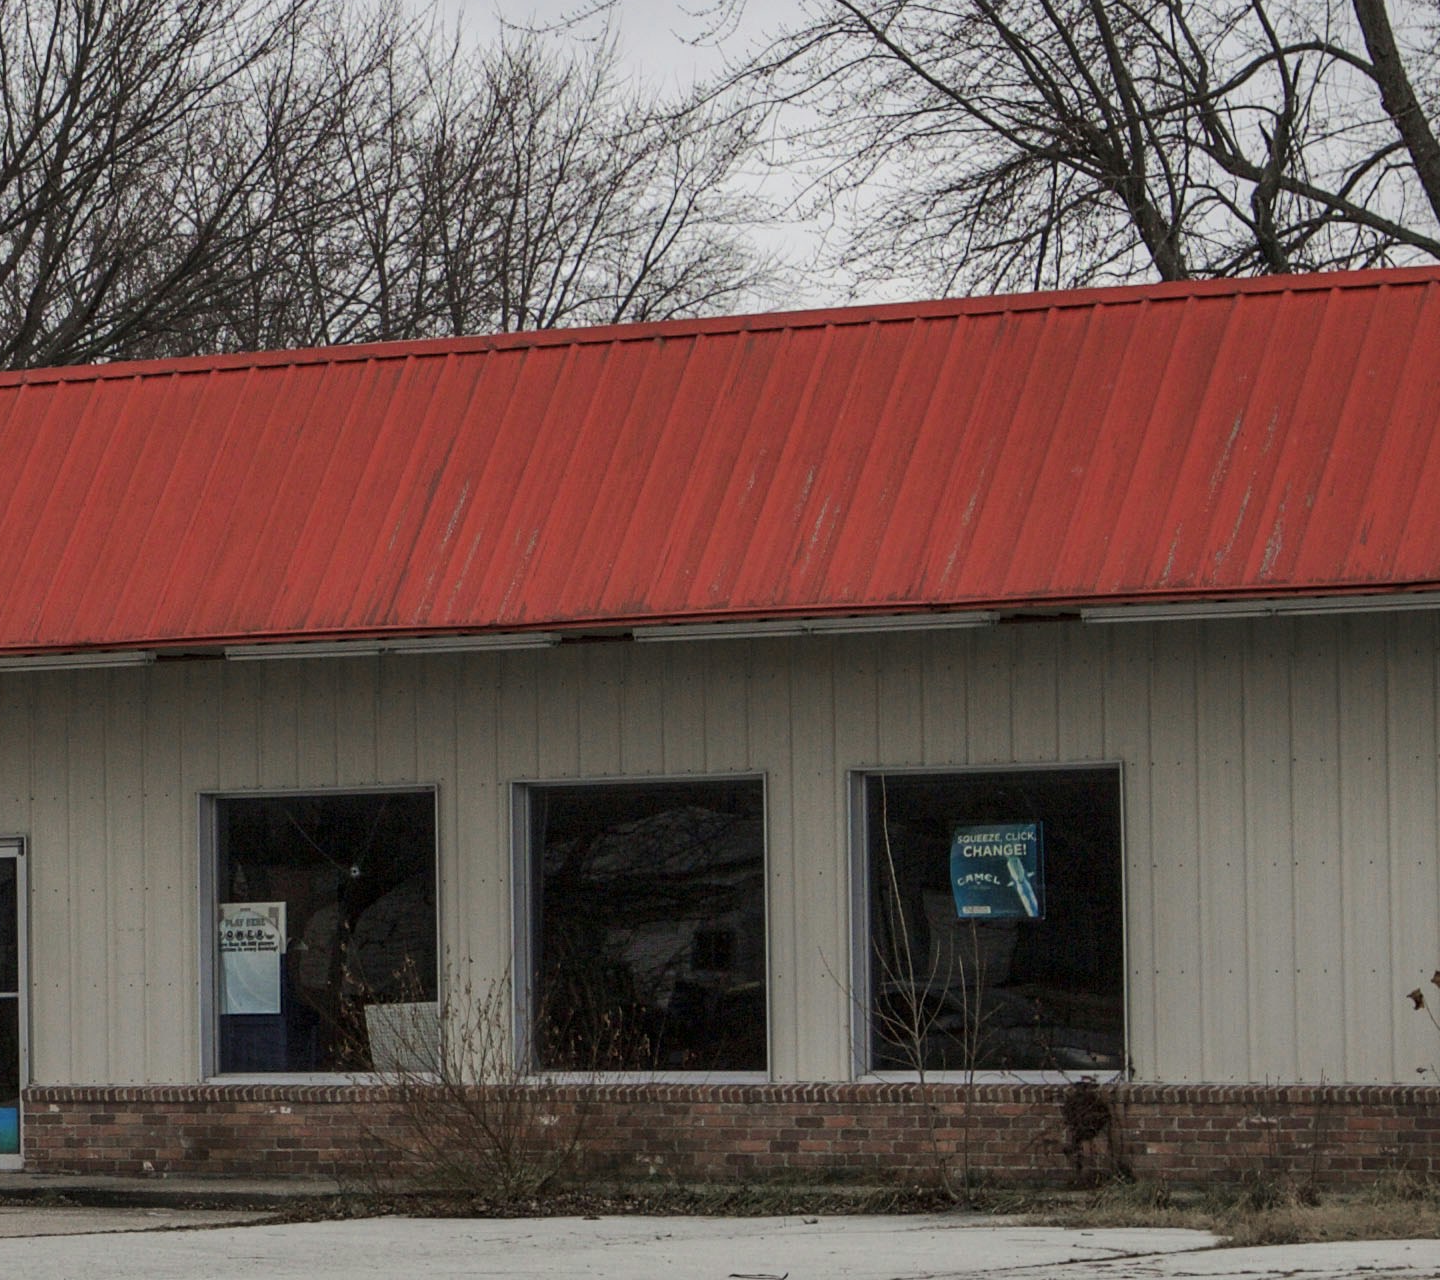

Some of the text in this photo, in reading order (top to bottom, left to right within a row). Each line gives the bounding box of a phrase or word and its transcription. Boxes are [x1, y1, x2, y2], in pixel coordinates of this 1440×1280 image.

[957, 832, 1036, 844] SQUEEZE, CLICK,
[963, 844, 1027, 857] CHANGE!
[957, 872, 1000, 886] CAMEL
